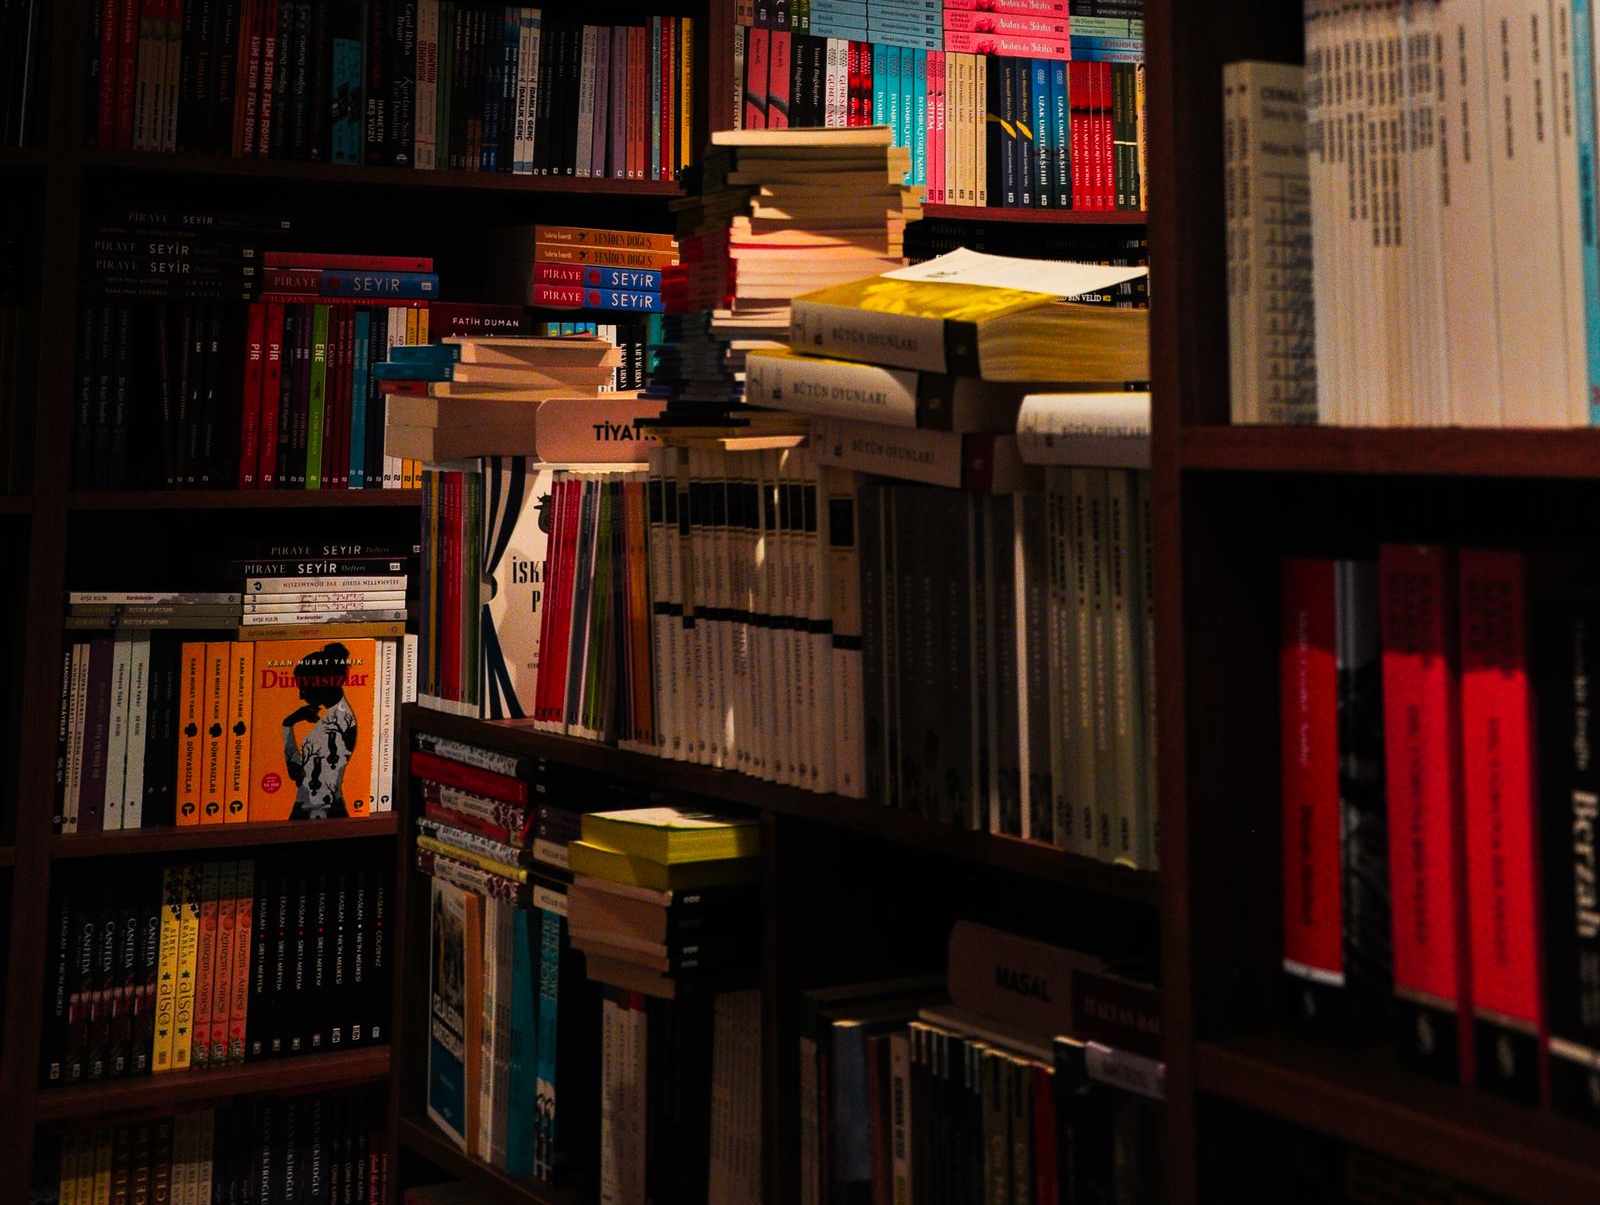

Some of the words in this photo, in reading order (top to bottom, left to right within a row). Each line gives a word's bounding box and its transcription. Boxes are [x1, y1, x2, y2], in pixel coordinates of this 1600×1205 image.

[366, 98, 376, 116] BEŞ
[517, 85, 527, 118] İDAMLIK
[527, 86, 537, 119] İDAMLIK
[1038, 95, 1046, 119] UZAK
[375, 99, 386, 143] İHANETİN
[927, 101, 936, 130] SİTEM
[936, 101, 945, 131] SİTEM
[367, 118, 377, 143] YÜZÜ
[515, 119, 525, 141] GENÇ
[526, 119, 535, 142] GENÇ
[1038, 119, 1046, 160] UMUTLAR
[1057, 119, 1066, 160] UMUTLAR
[1039, 160, 1048, 185] ŞEHRİ
[1058, 160, 1068, 185] ŞEHRİ
[148, 241, 190, 256] SEYİR
[592, 231, 625, 246] YENİDEN
[626, 233, 652, 247] DOĞUŞ
[149, 260, 190, 275] SEYİR
[593, 250, 625, 264] YENİDEN
[627, 252, 652, 266] DOĞUŞ
[274, 276, 317, 288] PİRAYE
[352, 276, 401, 293] SEYİR
[543, 268, 582, 281] PİRAYE
[611, 271, 654, 288] SEYİR
[543, 289, 582, 302] PİRAYE
[611, 293, 653, 309] SEYİR
[452, 316, 481, 326] FATİH
[483, 318, 520, 328] DUMAN
[831, 326, 865, 343] BÜTÜN
[866, 332, 917, 351] OYUNLARI
[250, 342, 262, 361] PİR
[268, 343, 281, 361] PİR
[314, 343, 325, 363] ENE
[792, 381, 829, 397] BÜTÜN
[831, 388, 888, 406] OYUNLARI
[593, 420, 657, 442] TİYAT
[852, 438, 883, 455] BÜTÜN
[883, 445, 935, 464] OYUNLARI
[322, 542, 362, 556] SEYİR
[244, 560, 287, 574] PİRAYE
[297, 560, 337, 575] SEYİR
[214, 658, 222, 676] KAAN
[266, 659, 293, 668] KAAN
[297, 658, 329, 667] MURAT
[333, 657, 363, 666] YANIK
[406, 643, 414, 684] SELAHATTİN
[189, 676, 197, 698] MURAT
[214, 677, 222, 700] MURAT
[260, 667, 369, 690] Dünyasızlar
[237, 698, 245, 718] YANIK
[383, 714, 391, 727] EVE
[382, 727, 390, 773] DÖNEMEZSİN
[184, 740, 194, 794] DÜNYASIZLAR
[209, 741, 219, 794] DÜNYASIZLAR
[233, 739, 242, 792] DÜNYASIZLAR
[80, 923, 94, 975] CANFEDA
[102, 921, 116, 973] CANFEDA
[124, 917, 137, 970] CANFEDA
[145, 916, 159, 967] CANFEDA
[161, 920, 170, 967] ERASLAN
[181, 918, 189, 965] ERASLAN
[255, 964, 264, 994] MERYEM
[275, 961, 284, 991] MERYEM
[294, 961, 304, 990] MERYEM
[314, 957, 324, 987] MERYEM
[988, 961, 1046, 1002] MASAL
